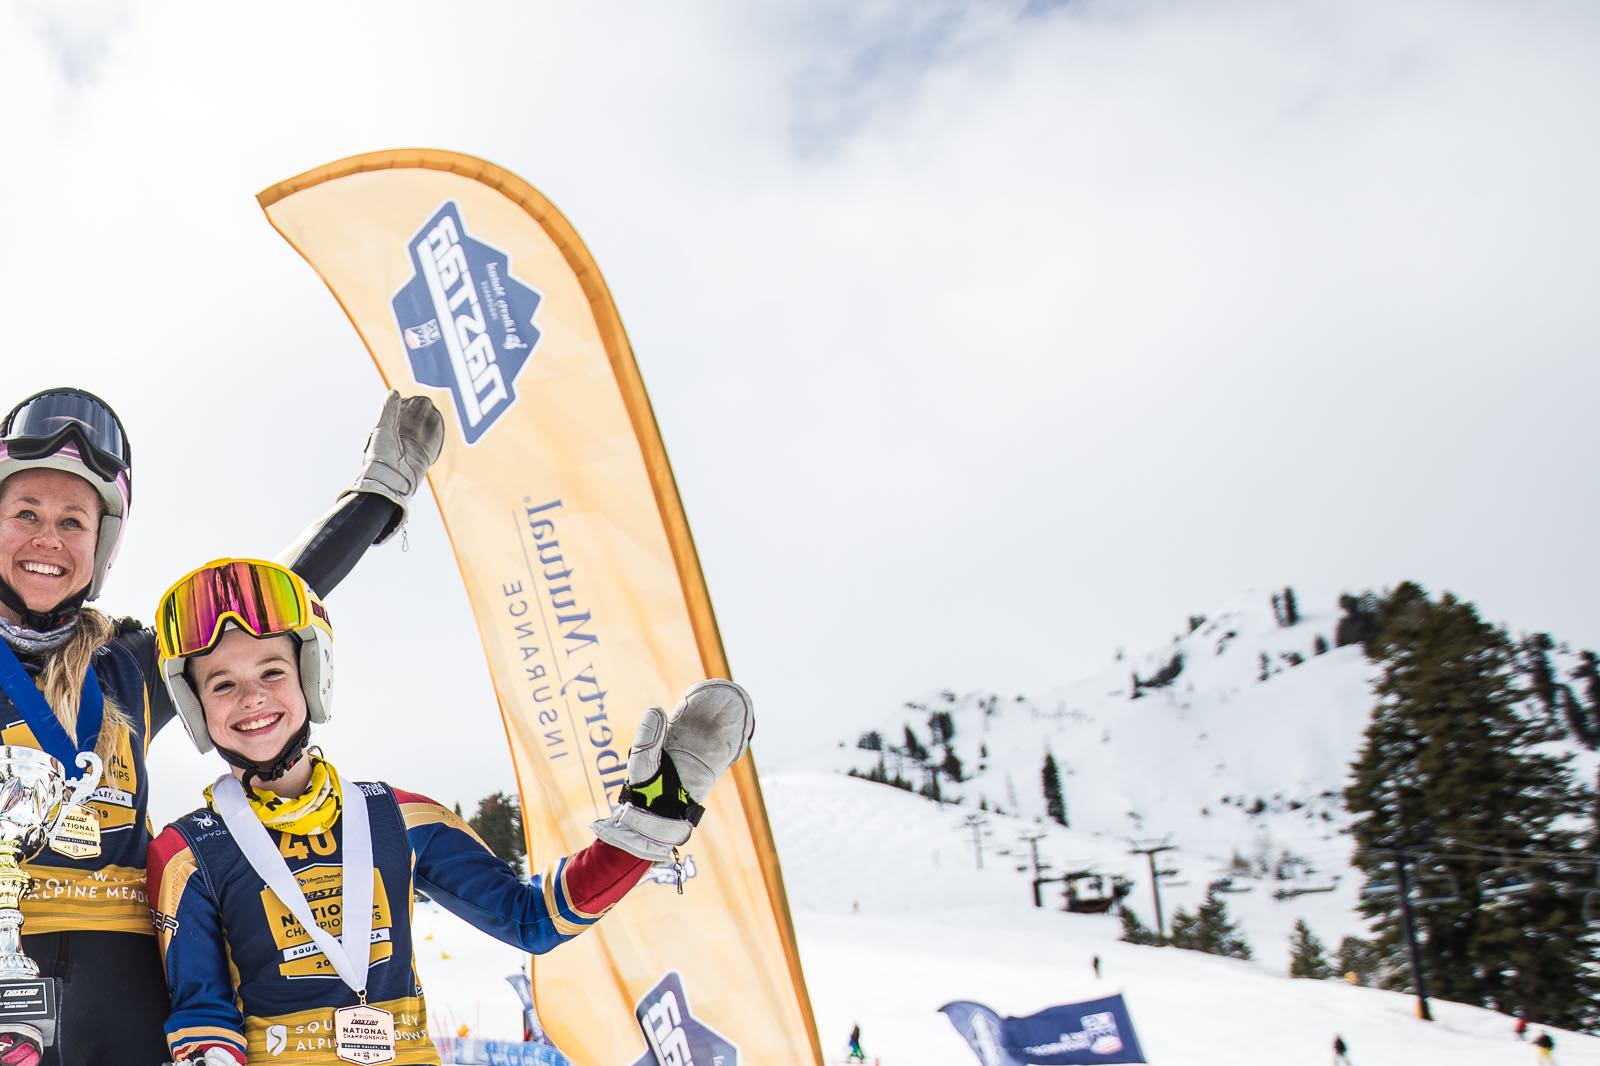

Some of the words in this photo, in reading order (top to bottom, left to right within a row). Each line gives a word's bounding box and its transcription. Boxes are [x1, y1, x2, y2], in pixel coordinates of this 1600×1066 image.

[60, 821, 96, 832] ATIONAL
[195, 829, 228, 843] SPYDE
[279, 828, 337, 860] 40
[106, 887, 148, 904] MEAD
[292, 945, 318, 956] SQUA
[315, 959, 332, 969] 20
[295, 1019, 334, 1035] SQU
[342, 1026, 388, 1036] NATIONAL
